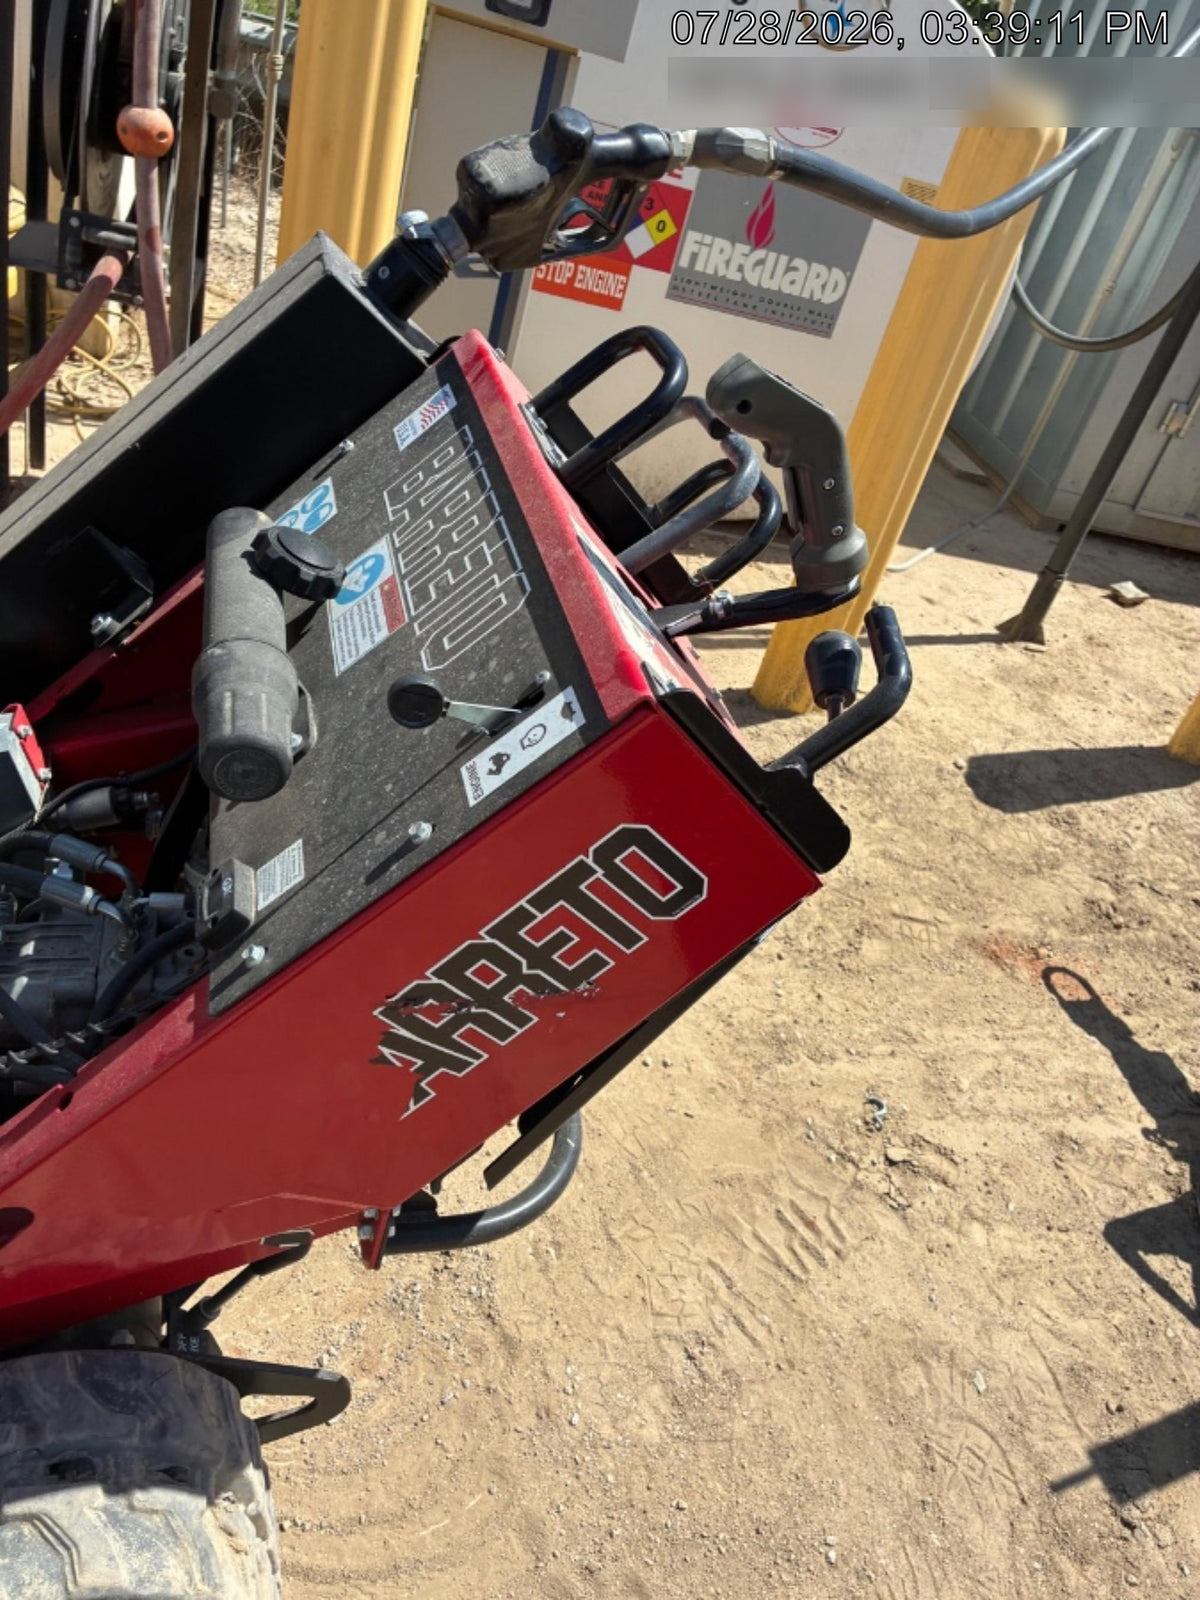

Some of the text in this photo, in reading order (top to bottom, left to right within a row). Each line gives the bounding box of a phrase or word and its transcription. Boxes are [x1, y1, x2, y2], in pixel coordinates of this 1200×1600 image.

[656, 220, 667, 233] 0
[535, 260, 627, 299] STOP ENGINE
[808, 309, 835, 321] WALL
[383, 424, 532, 671] BARRETO
[465, 760, 485, 801] ENGINE
